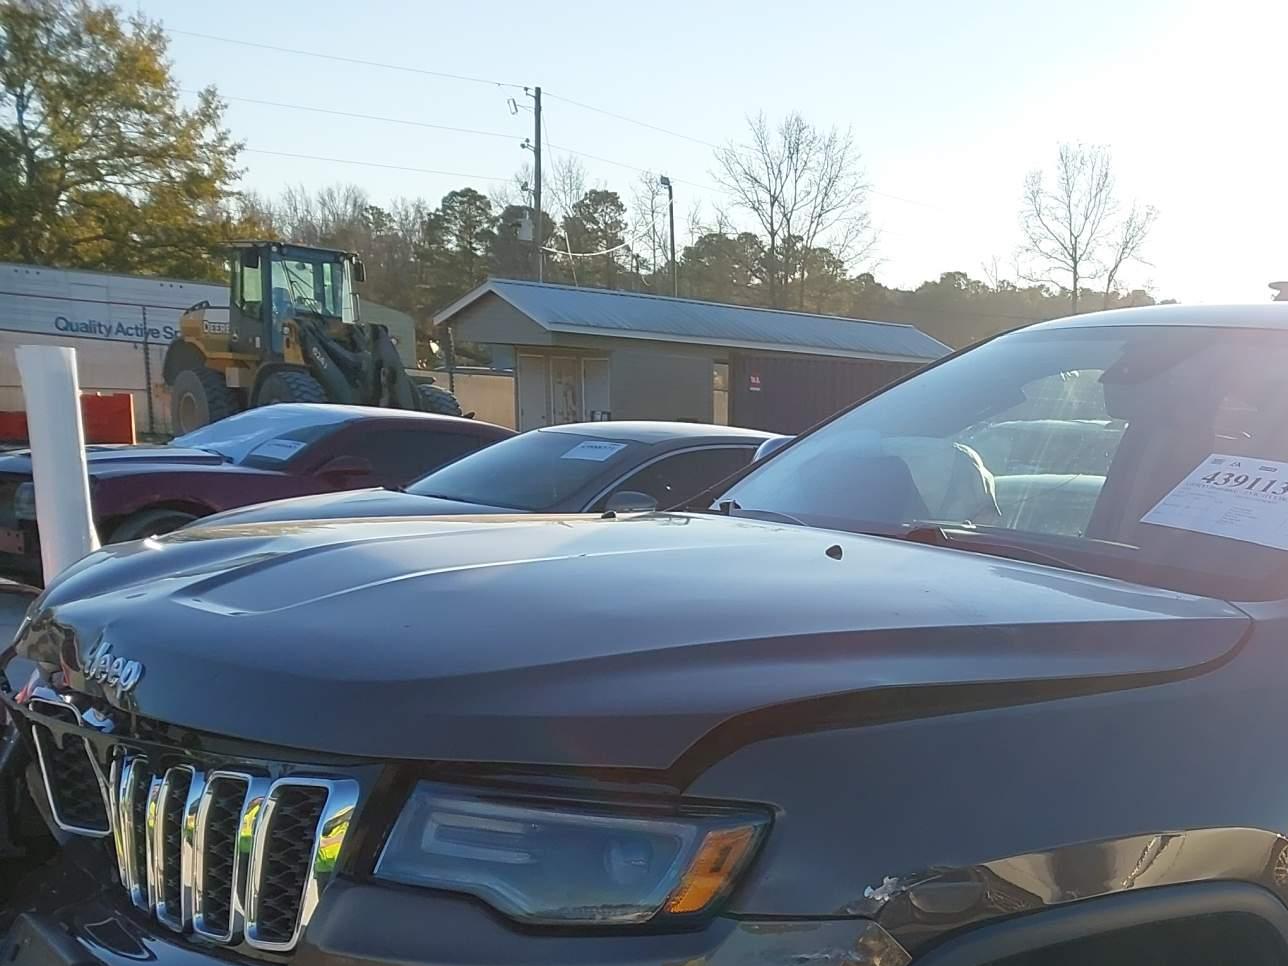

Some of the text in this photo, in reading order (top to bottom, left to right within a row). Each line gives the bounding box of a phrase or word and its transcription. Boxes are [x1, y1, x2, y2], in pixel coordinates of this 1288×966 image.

[54, 316, 112, 338] Quality
[115, 321, 160, 339] Active
[203, 319, 231, 334] DEERE
[84, 642, 144, 699] Jeep
